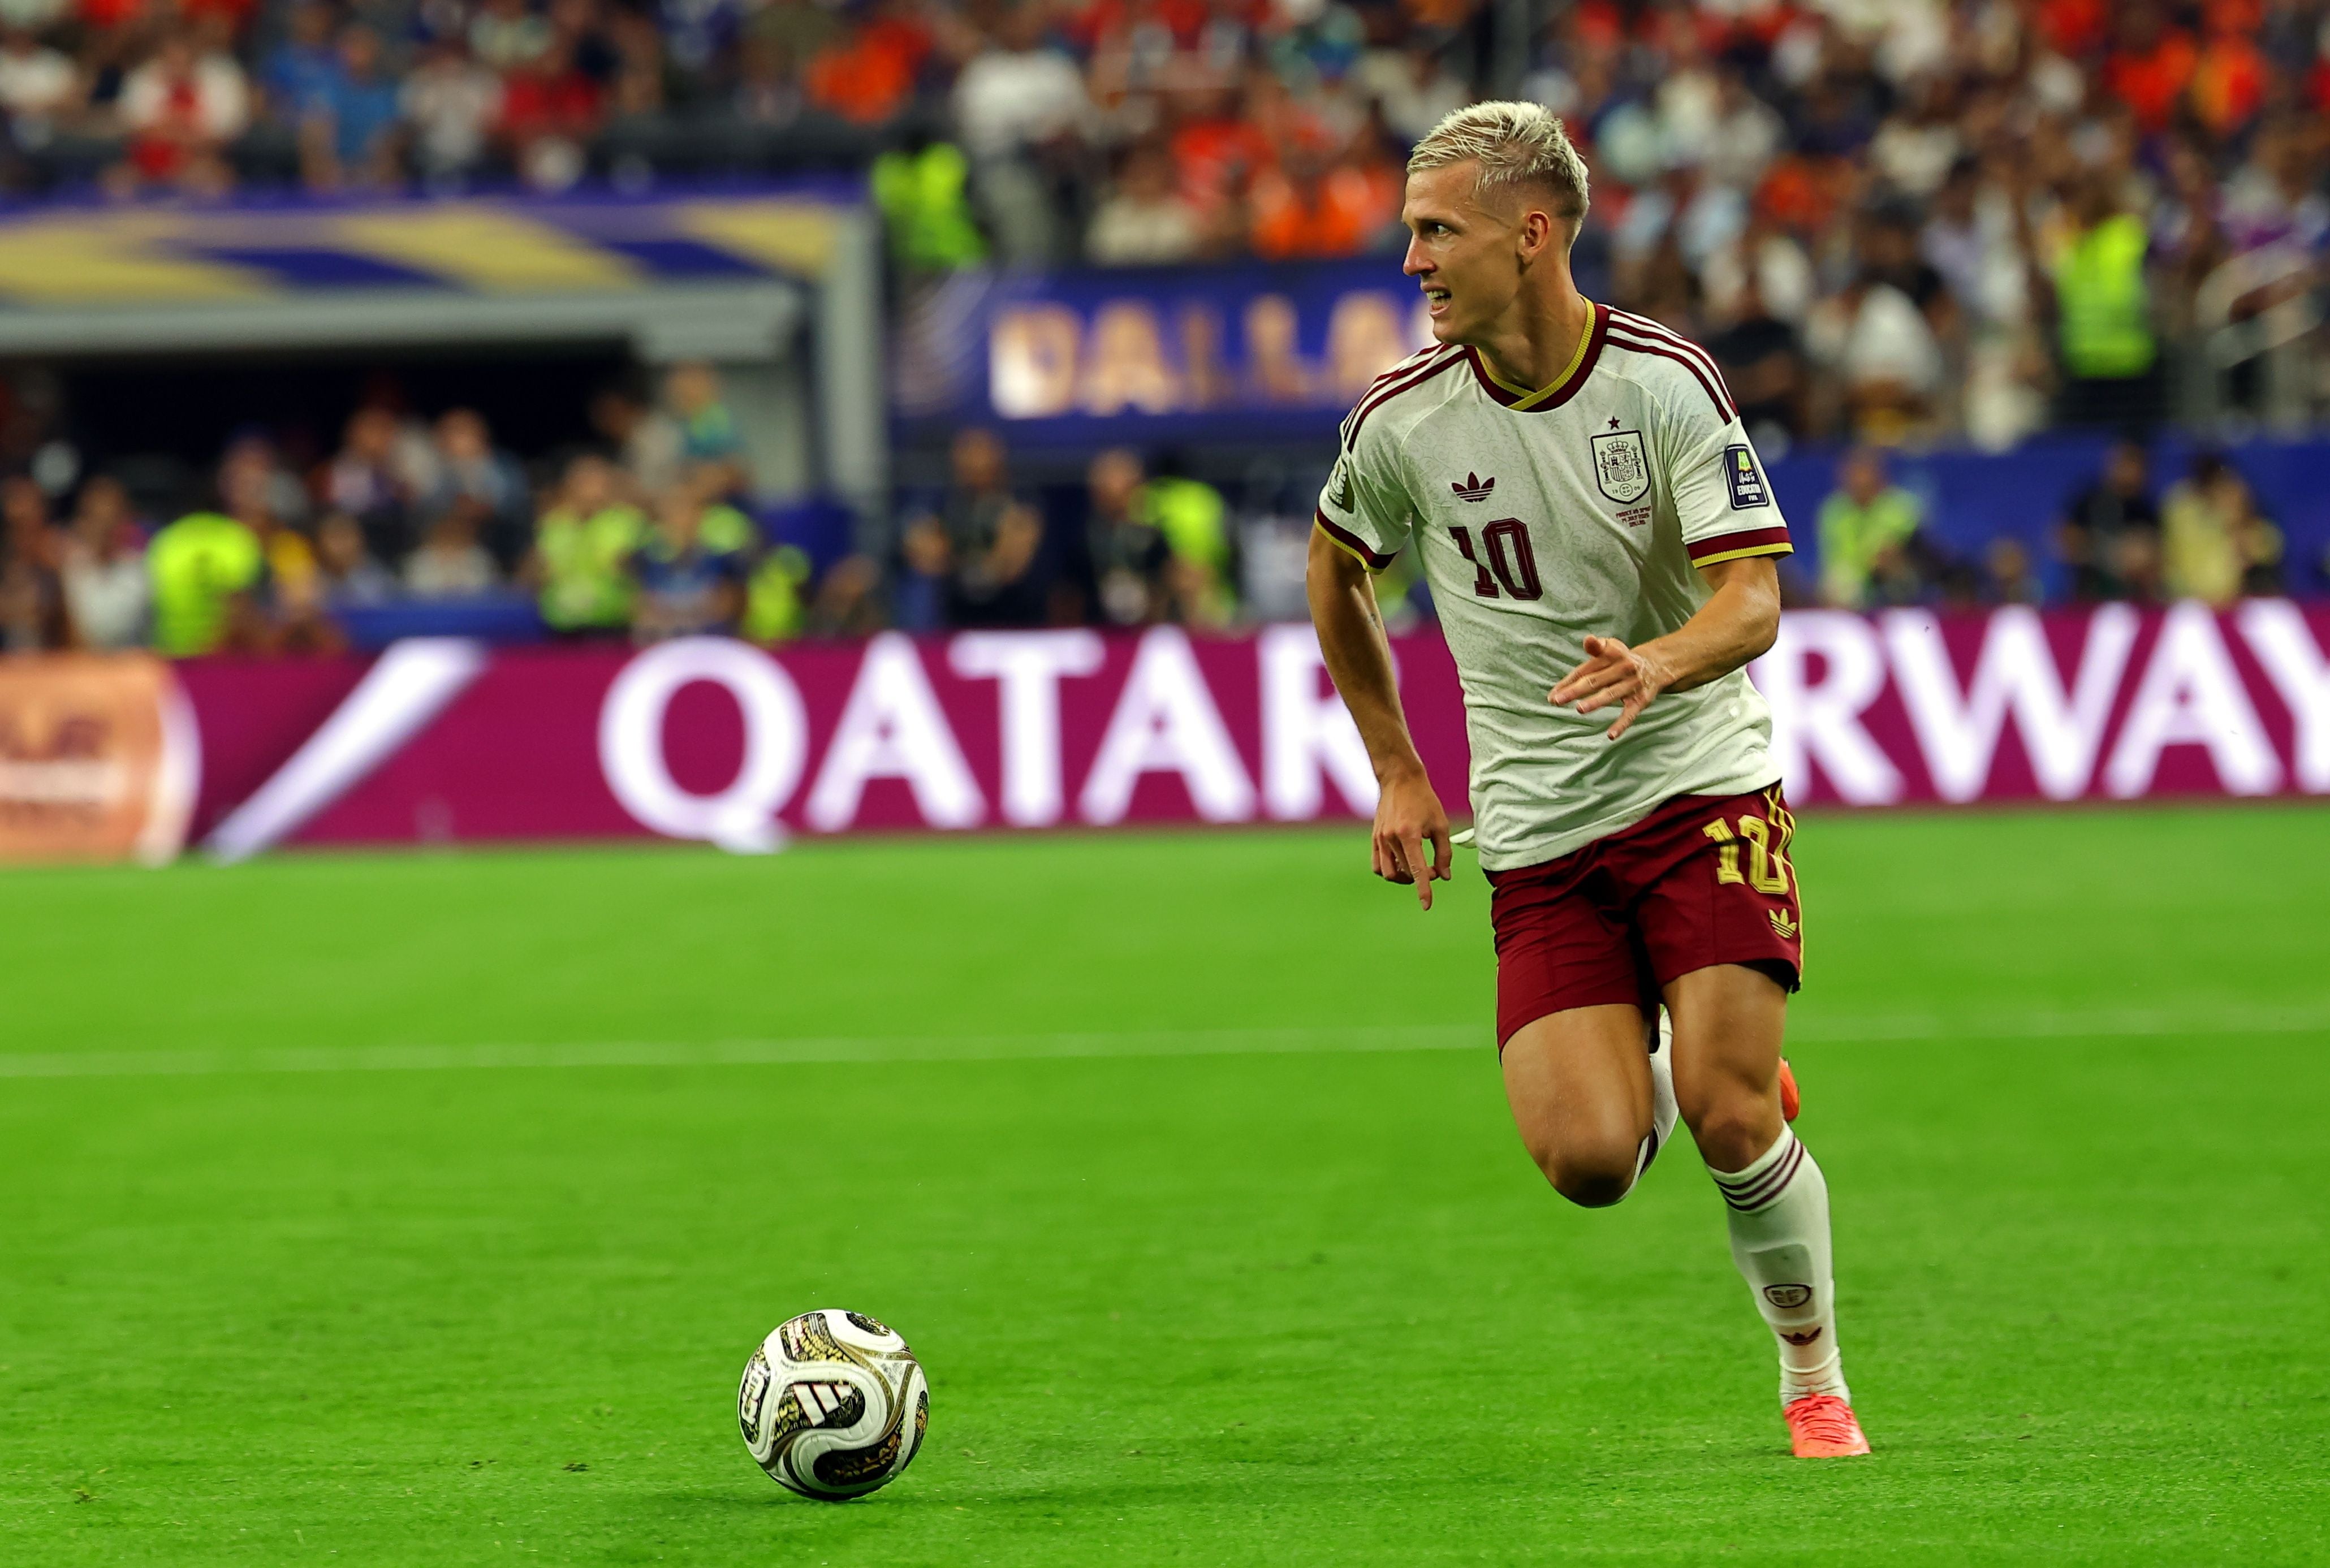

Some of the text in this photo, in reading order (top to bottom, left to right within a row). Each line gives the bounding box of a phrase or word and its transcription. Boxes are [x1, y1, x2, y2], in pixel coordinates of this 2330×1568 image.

[990, 291, 1435, 418] DALLA
[1447, 517, 1543, 601] 10
[597, 622, 1401, 853] QATAR
[1702, 814, 1790, 895] 10
